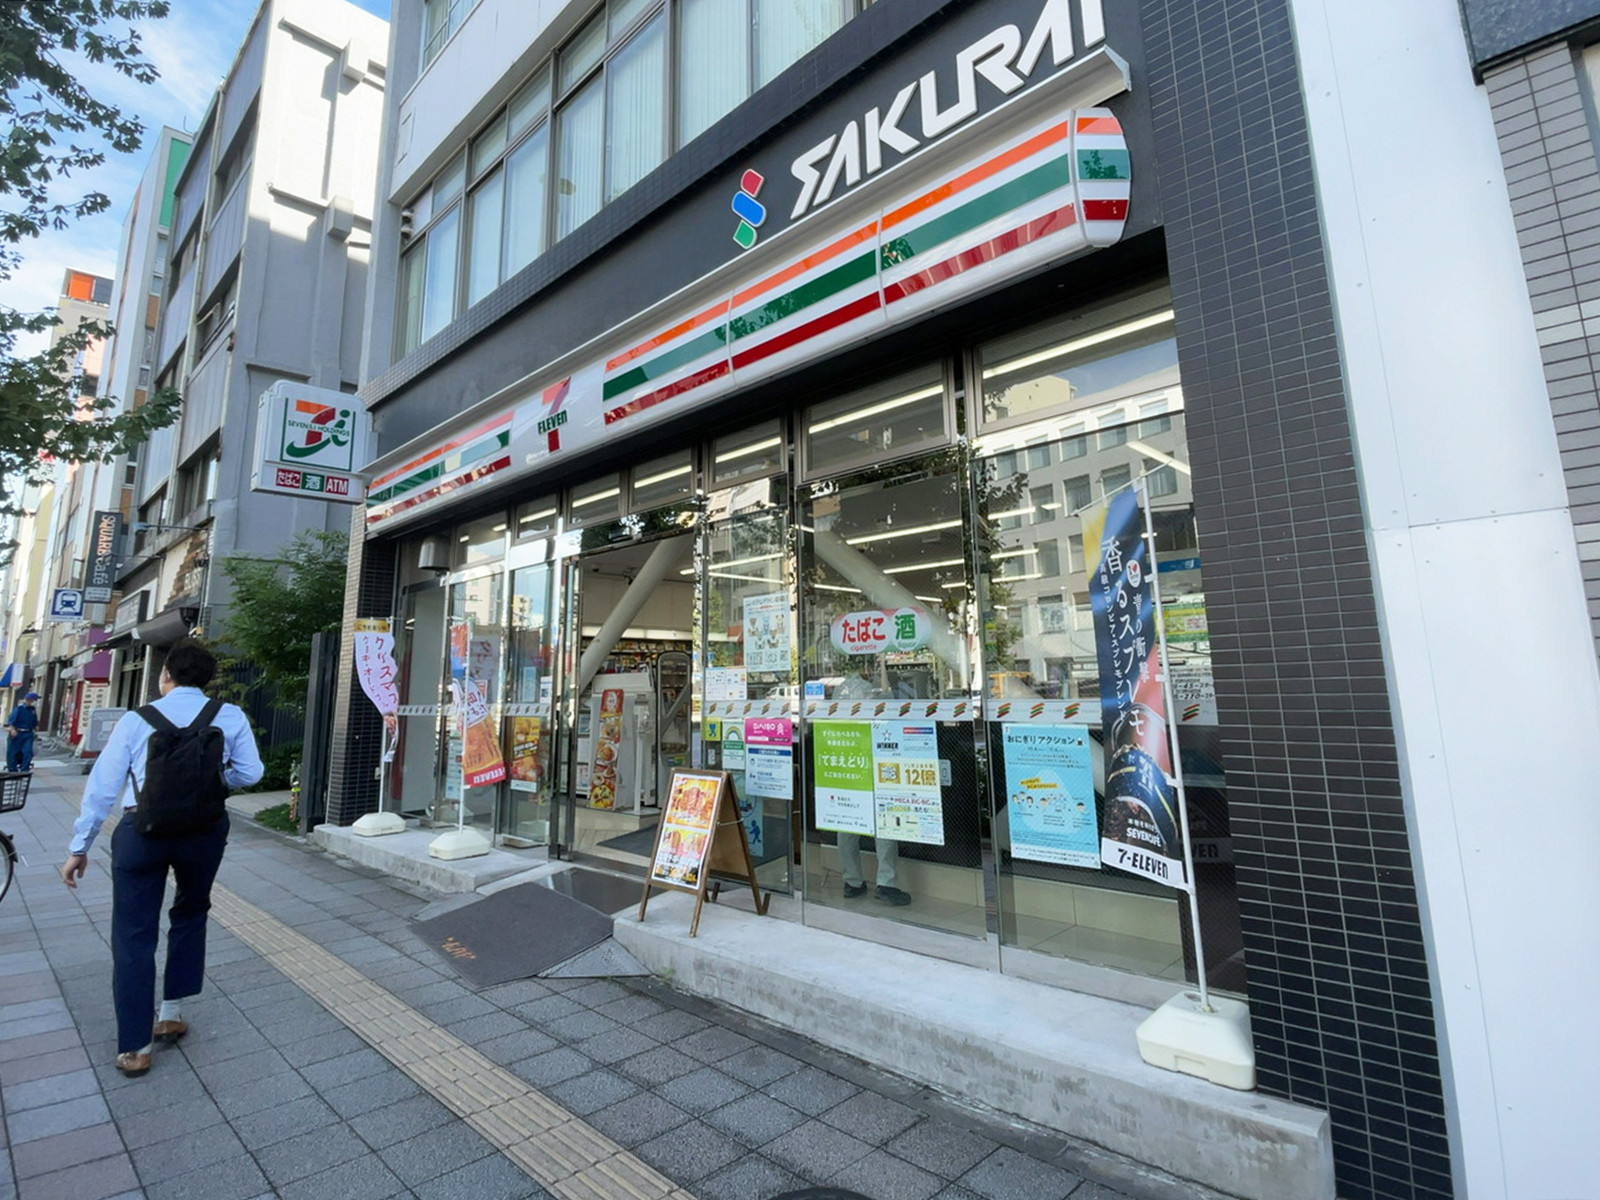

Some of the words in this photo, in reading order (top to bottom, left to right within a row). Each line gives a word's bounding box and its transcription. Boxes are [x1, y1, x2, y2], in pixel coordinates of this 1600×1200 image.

[789, 0, 1106, 220] SAKURAI
[277, 470, 300, 487] たばこ
[305, 475, 320, 490] 酒
[326, 477, 348, 494] ATM
[842, 617, 886, 644] たばこ
[894, 613, 916, 640] 酒
[753, 722, 776, 732] DAISO
